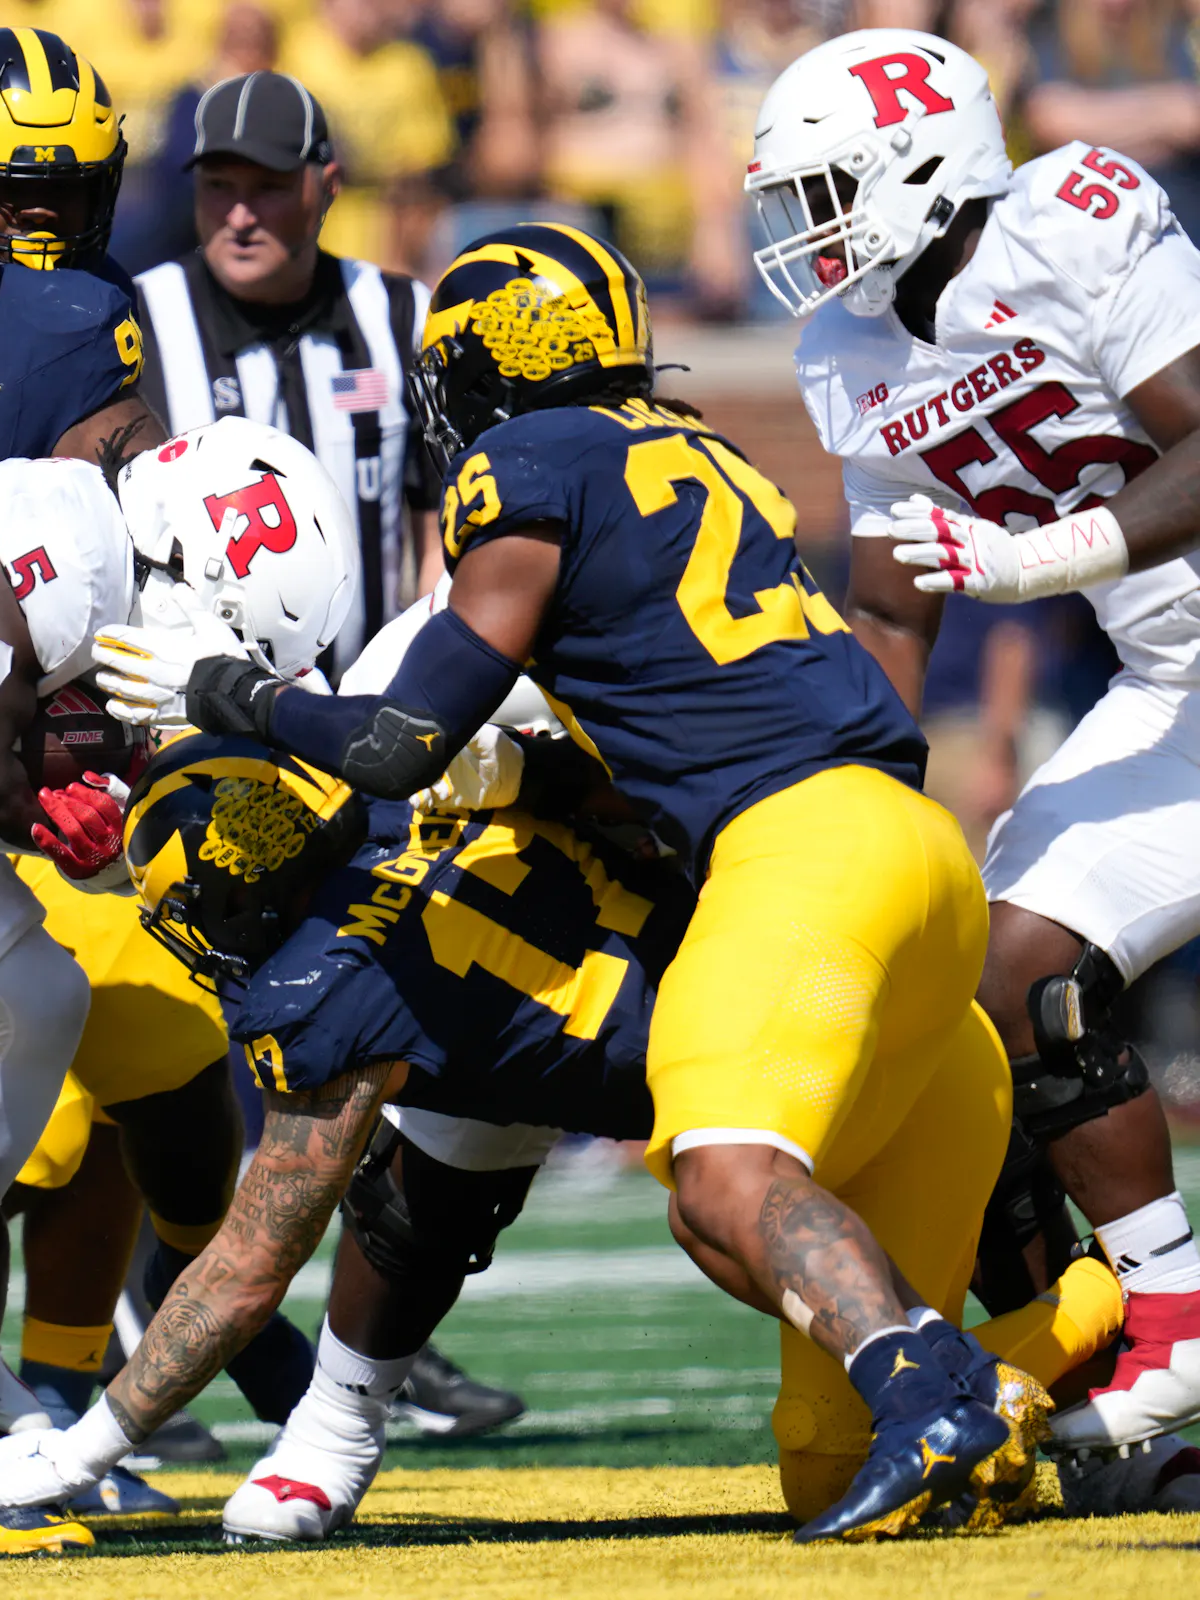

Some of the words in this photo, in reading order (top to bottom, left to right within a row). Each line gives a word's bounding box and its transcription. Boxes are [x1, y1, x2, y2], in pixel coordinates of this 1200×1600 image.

[847, 52, 955, 129] R
[34, 147, 56, 162] M
[1055, 149, 1141, 220] 55
[573, 342, 595, 363] 25
[213, 376, 240, 409] S
[880, 337, 1047, 457] RUTGERS
[357, 457, 380, 500] U
[442, 452, 502, 559] 25
[203, 471, 297, 579] R
[4, 545, 59, 602] 5
[62, 730, 104, 745] DIME
[219, 848, 234, 864] TED
[421, 808, 656, 1041] 17
[244, 1033, 294, 1094] 17
